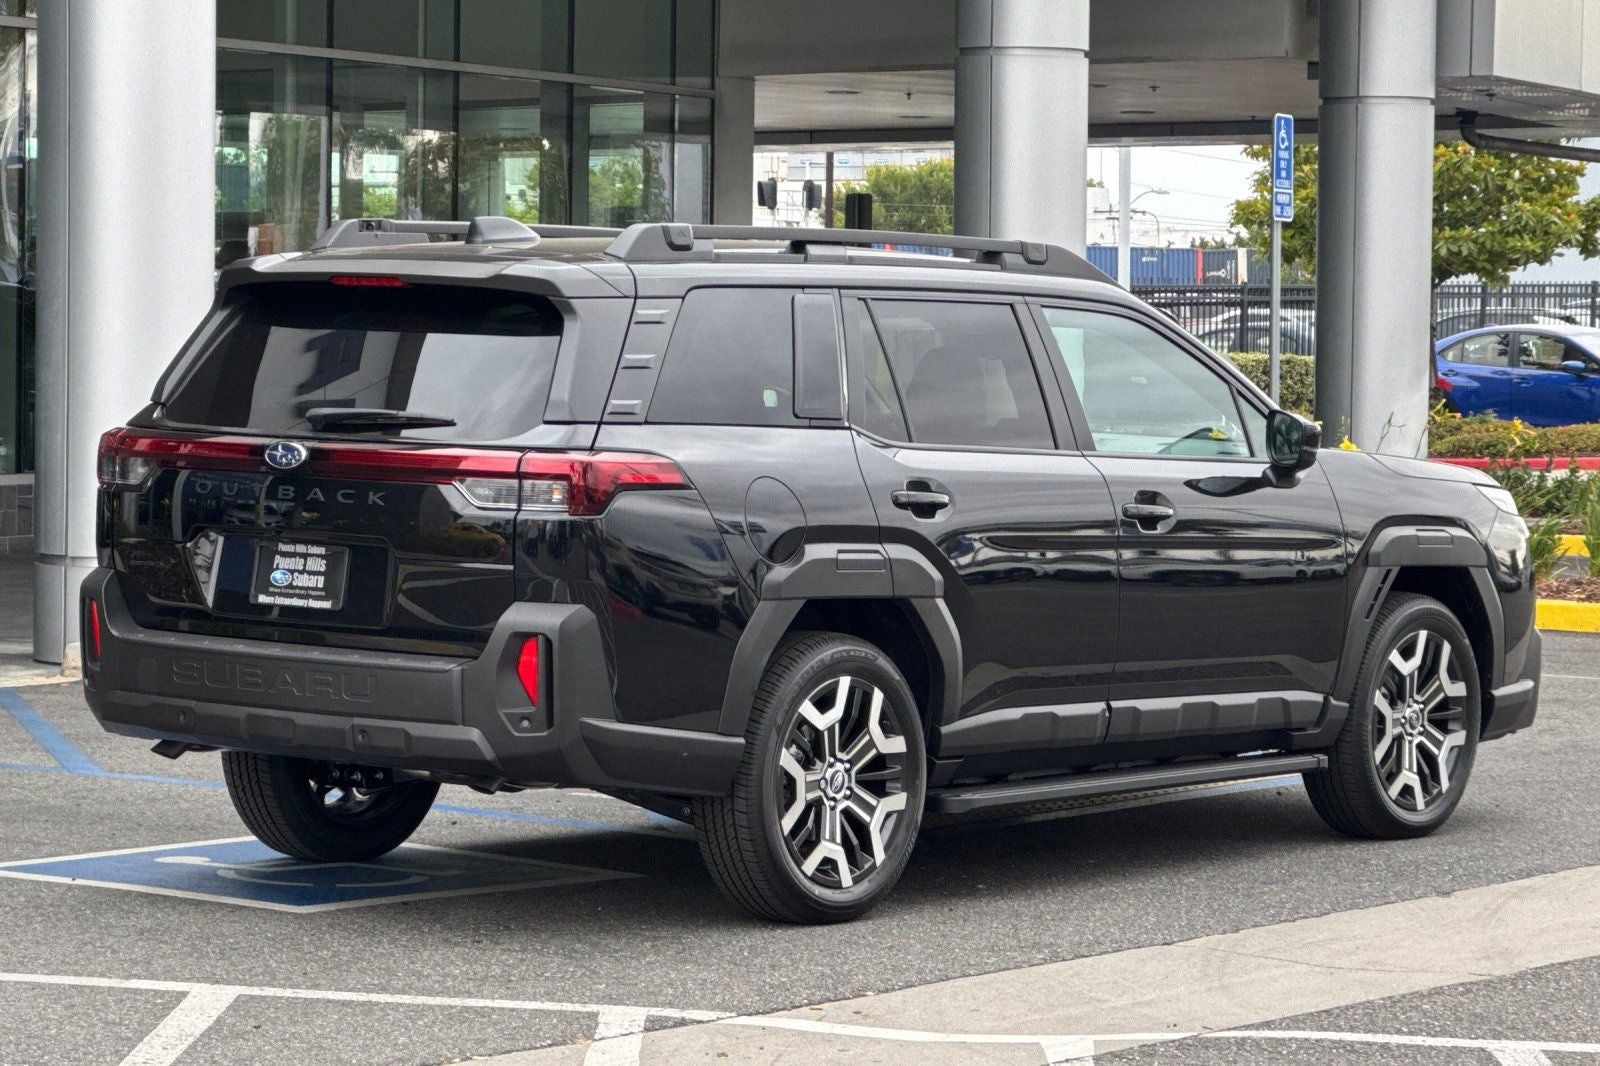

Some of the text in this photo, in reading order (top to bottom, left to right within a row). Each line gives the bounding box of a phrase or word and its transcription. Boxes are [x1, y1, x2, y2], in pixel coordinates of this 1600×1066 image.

[194, 479, 386, 506] OUTBACK
[278, 542, 326, 555] Puente Hills Subaru
[273, 554, 327, 572] Puente Hills
[292, 572, 325, 588] Subaru
[257, 594, 275, 604] Where
[275, 595, 308, 608] Extraordinary
[172, 658, 378, 703] SUBARU
